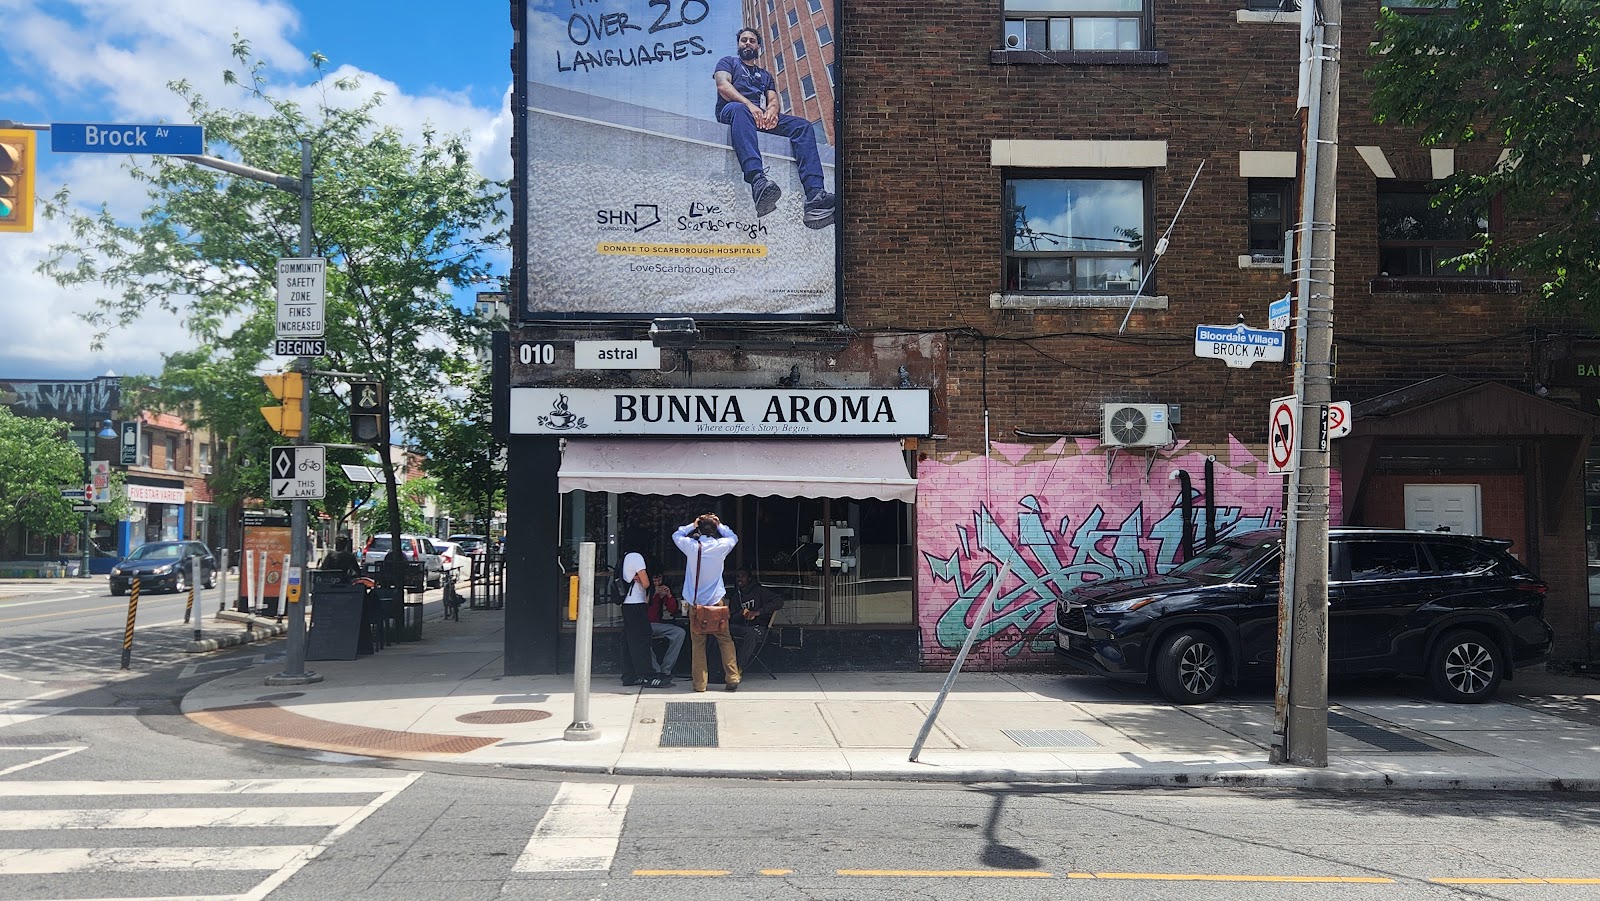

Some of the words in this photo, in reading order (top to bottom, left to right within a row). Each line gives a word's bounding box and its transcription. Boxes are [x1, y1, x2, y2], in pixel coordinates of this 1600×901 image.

[568, 12, 642, 46] OVER
[648, 0, 709, 34] 20
[556, 35, 712, 73] LANGUAGES.
[85, 125, 147, 146] Brock
[155, 127, 169, 138] Av
[597, 210, 637, 225] SHN
[677, 215, 768, 239] Scarborough
[652, 246, 715, 254] SCARBOROUGH
[280, 263, 322, 274] COMMUNITY
[630, 263, 736, 275] LoveScarborough.ca
[286, 277, 316, 287] SAFETY
[290, 291, 311, 301] ZONE
[289, 307, 312, 317] FINES
[278, 321, 321, 331] INCREASED
[1200, 330, 1246, 343] Bloordale
[1248, 333, 1280, 346] Village
[278, 341, 322, 354] BEGINS
[519, 343, 555, 364] 010
[598, 347, 638, 360] astral
[1213, 342, 1249, 357] BROCK
[1253, 346, 1267, 358] AV.
[1577, 364, 1600, 377] BA
[614, 394, 745, 422] BUNNA
[761, 395, 897, 423] AROMA
[696, 423, 723, 432] Where
[724, 423, 756, 433] coffee's
[757, 423, 780, 433] Story
[782, 424, 810, 433] Begins
[297, 480, 315, 488] THIS
[131, 487, 143, 498] FIVE
[145, 488, 159, 499] STAR
[161, 490, 183, 501] VARIETY
